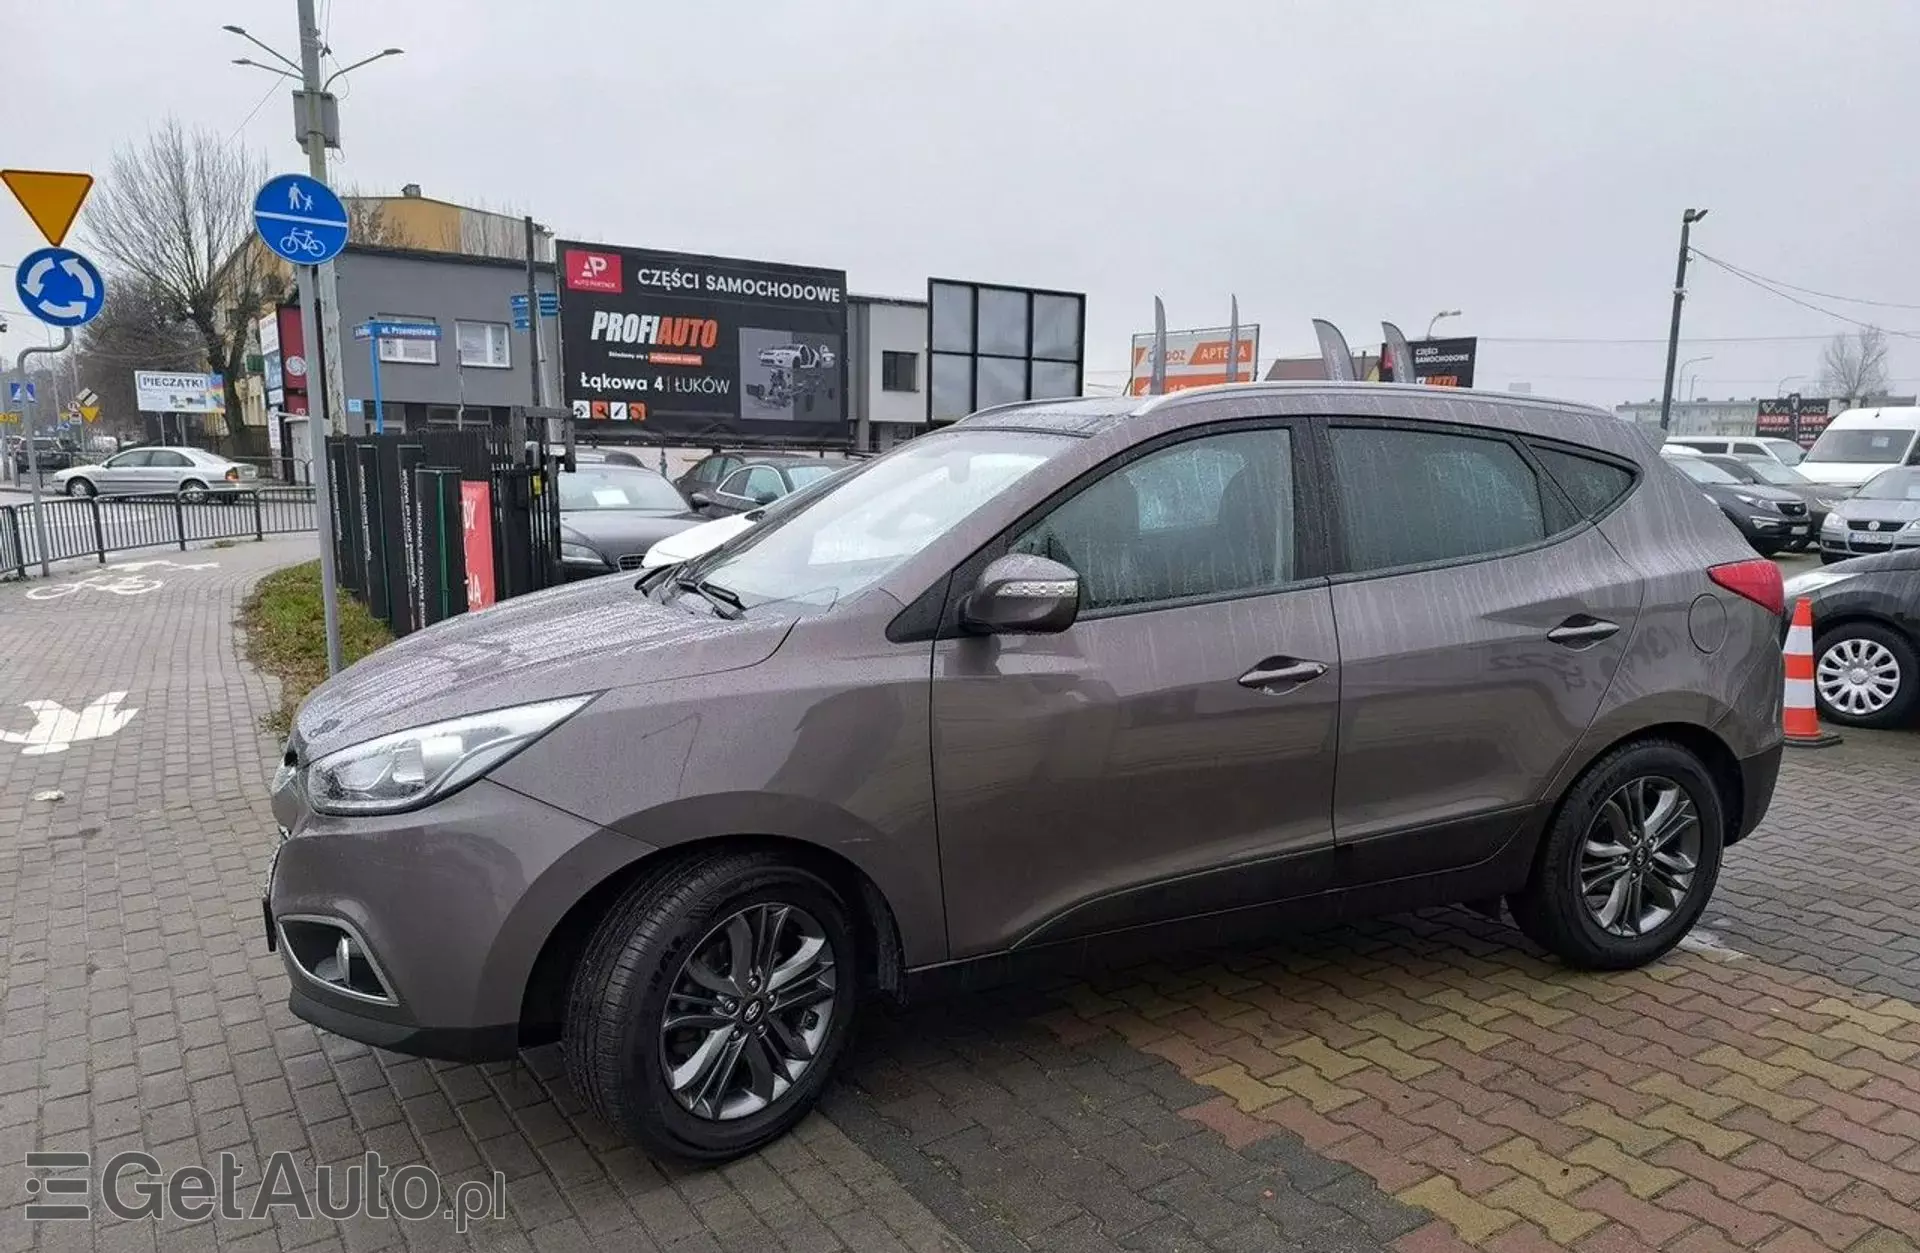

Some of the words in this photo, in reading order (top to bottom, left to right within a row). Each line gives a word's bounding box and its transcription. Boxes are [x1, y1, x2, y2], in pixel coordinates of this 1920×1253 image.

[637, 267, 700, 291] CZĘŚCI
[706, 275, 840, 303] SAMOCHODOWE
[591, 310, 718, 349] PROFIAUTO
[1200, 345, 1247, 361] APTEA
[580, 371, 648, 393] Łąkowa
[654, 376, 664, 392] 4
[675, 376, 731, 395] ŁUKÓW
